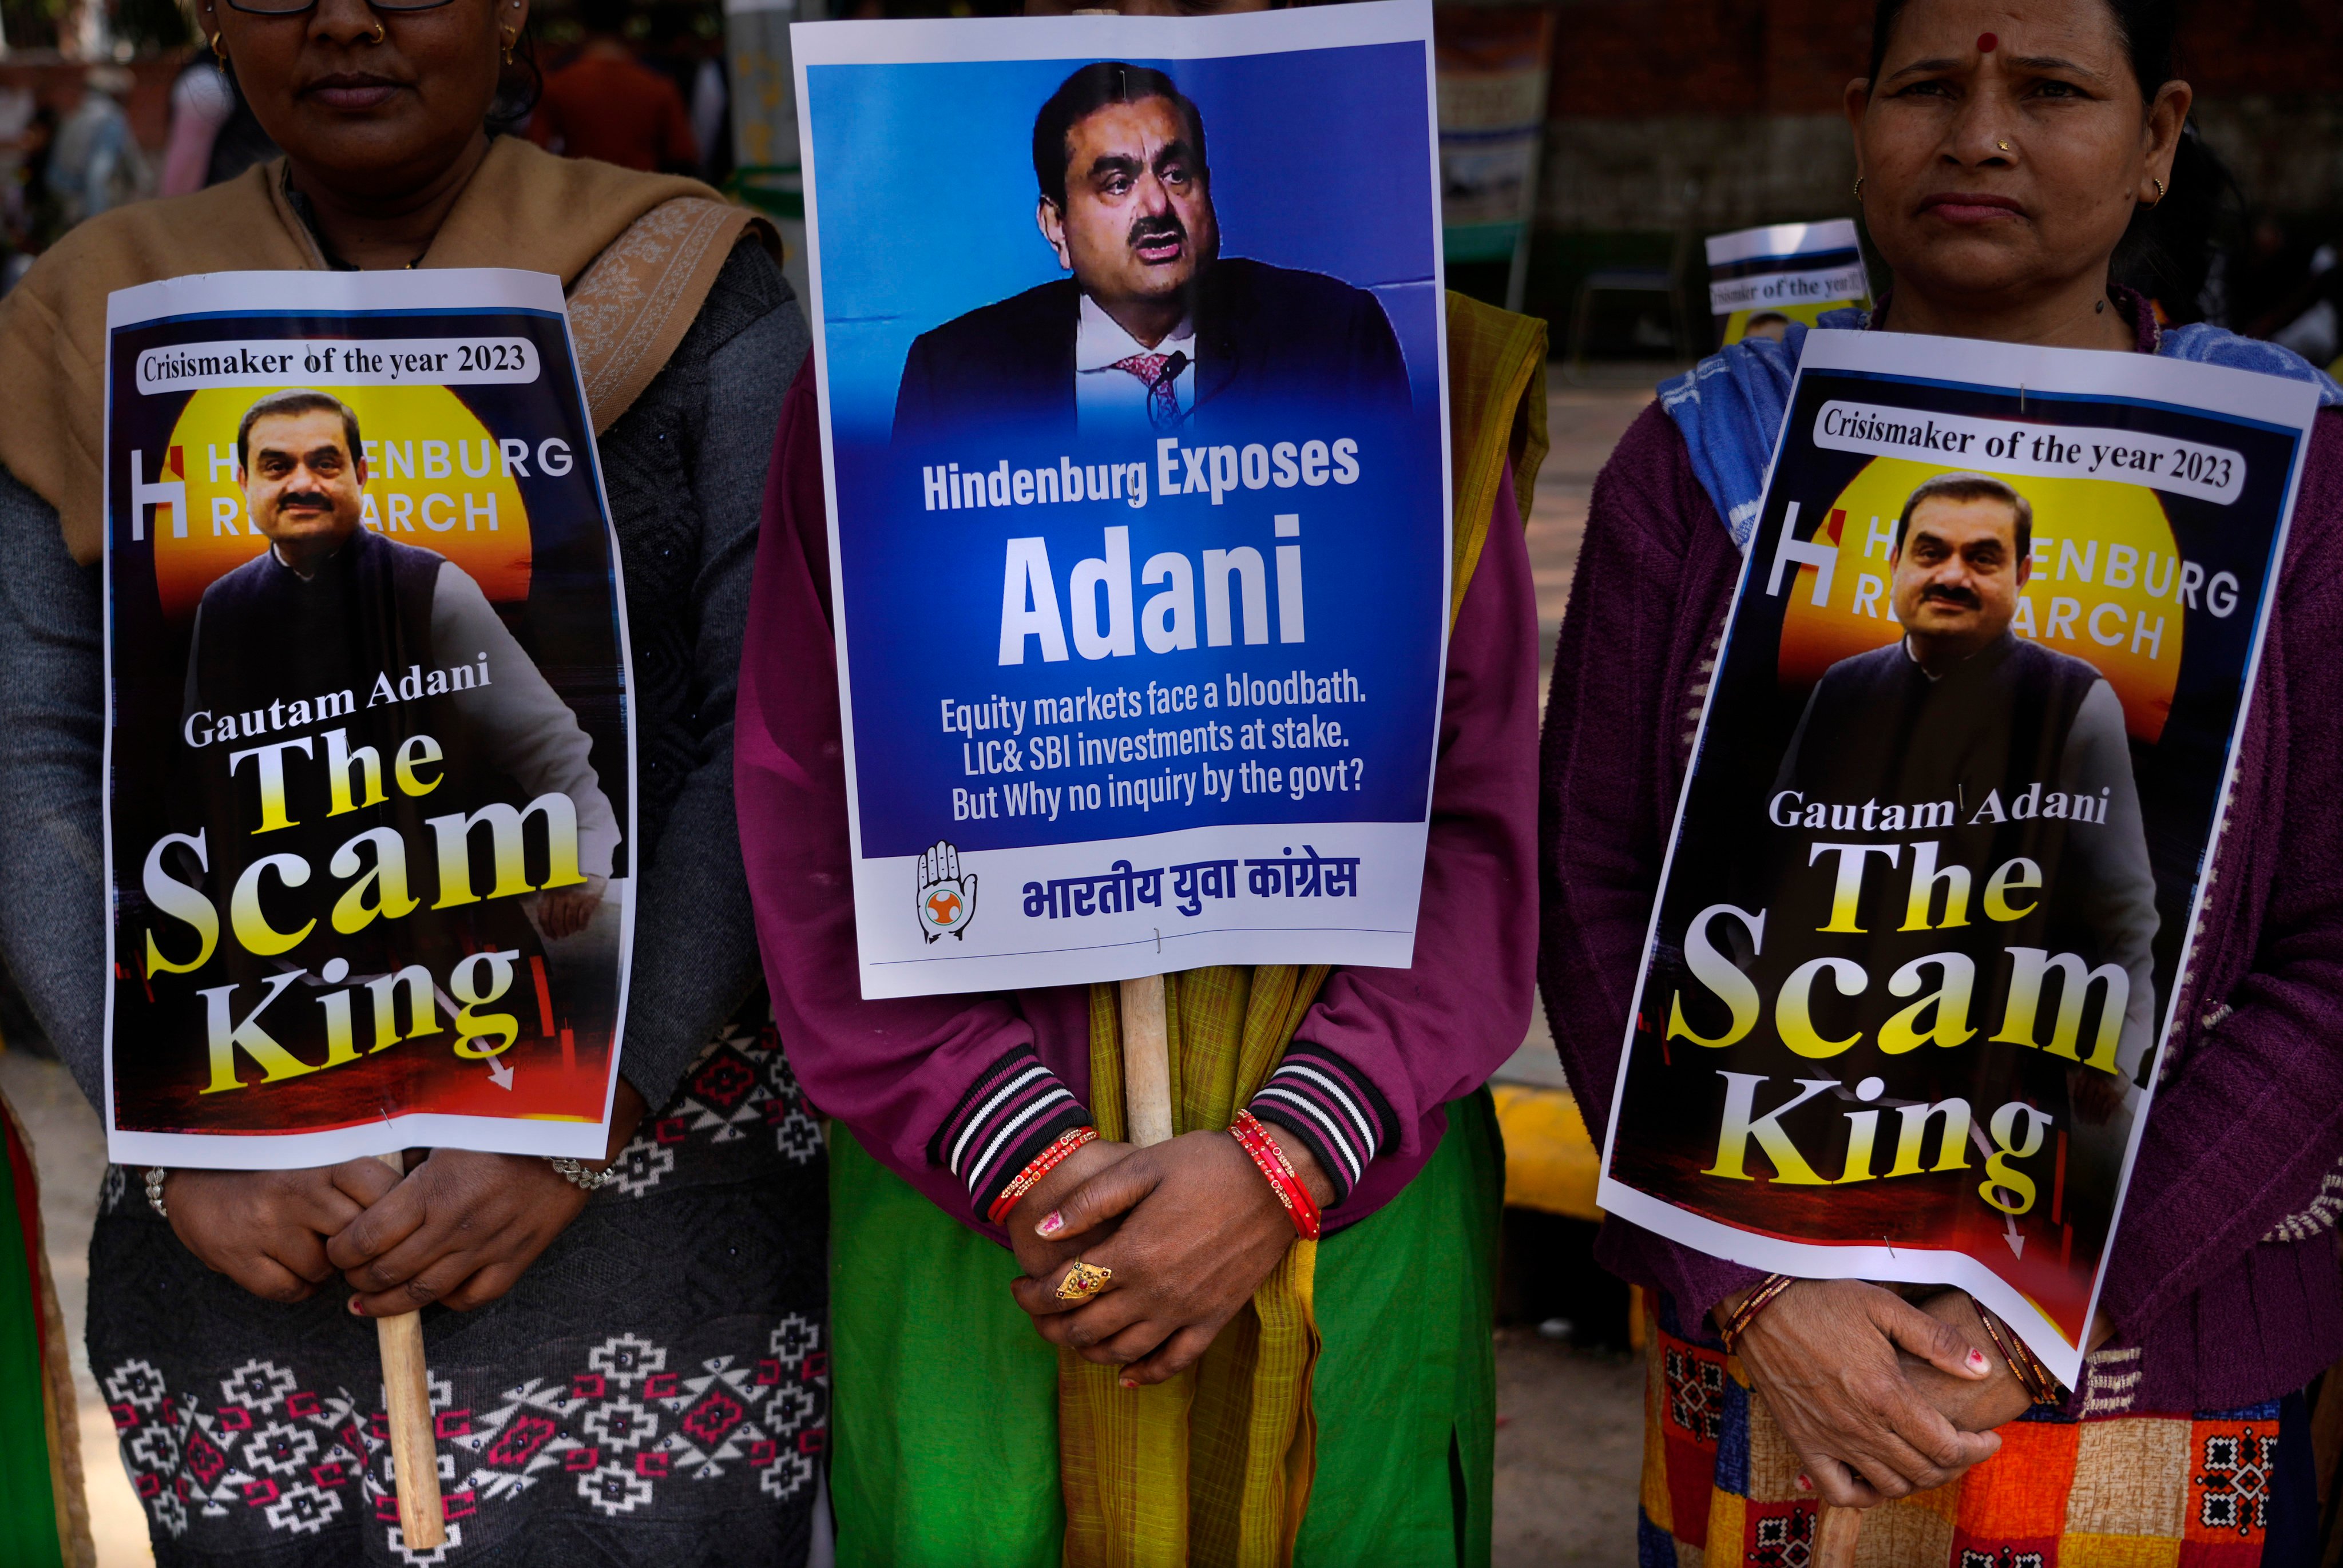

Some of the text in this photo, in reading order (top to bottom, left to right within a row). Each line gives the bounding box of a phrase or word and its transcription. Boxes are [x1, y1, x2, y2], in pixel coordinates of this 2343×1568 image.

[1763, 279, 1784, 298] of
[1789, 277, 1820, 296] the
[144, 344, 526, 383] Crisismaker of the year 2023
[208, 438, 573, 483] HENBURG
[923, 437, 1360, 511] Hindenburg Exposes
[1823, 408, 2234, 490] Crisismaker of the year 2023
[998, 514, 1306, 666] Adani
[1864, 515, 2239, 618] HENBURG
[184, 652, 492, 748] Gautam Adani
[941, 669, 1366, 737] Equity markets face a bloodbath.
[230, 728, 445, 835] The
[963, 714, 1349, 776] LIC& SBI investments at stake.
[953, 758, 1364, 822] But Why no inquiry by the govt?
[1768, 783, 2110, 831] Gautam Adani
[142, 792, 588, 980] Scam
[1022, 844, 1360, 920] भारतीय युवा कांग्रेस
[1807, 840, 2042, 934] The
[196, 948, 520, 1095] King
[1666, 903, 2130, 1075] Scam
[1700, 1070, 2053, 1215] King
